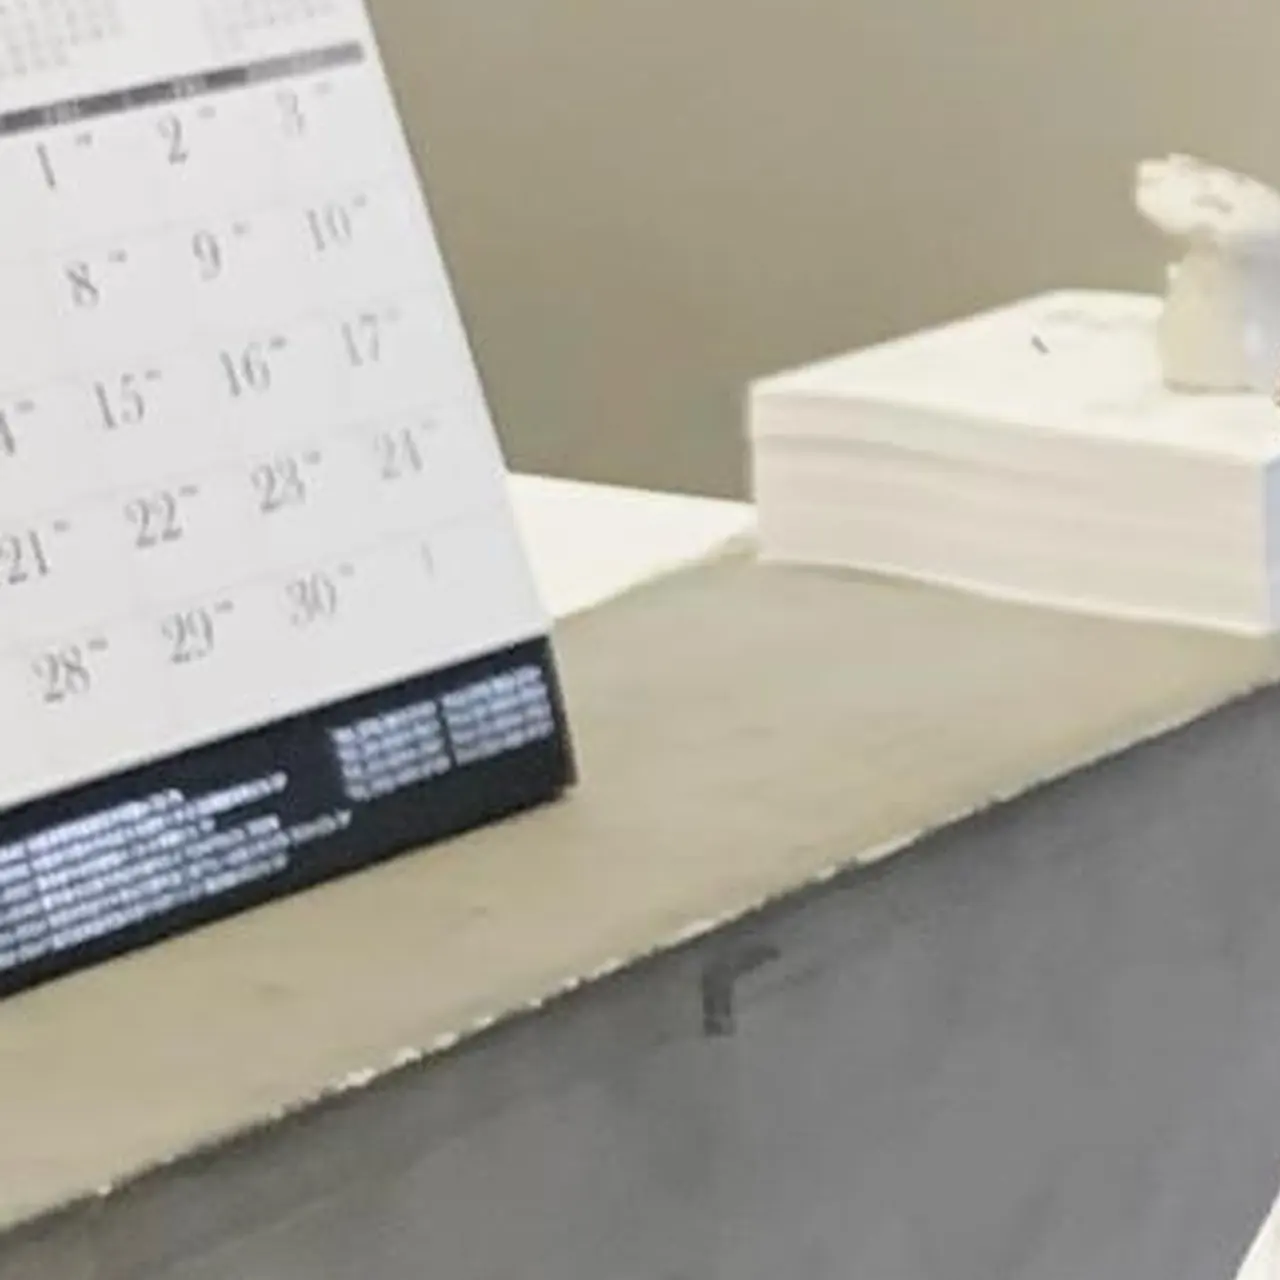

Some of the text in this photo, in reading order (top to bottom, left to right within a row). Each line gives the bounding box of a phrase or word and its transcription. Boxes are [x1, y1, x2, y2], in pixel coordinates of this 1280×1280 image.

[157, 113, 189, 165] 2
[64, 202, 353, 308] 8 9 10
[93, 312, 381, 430] 15 16 17
[0, 529, 49, 585] 21
[125, 489, 184, 550] 22
[251, 455, 307, 513] 23
[31, 645, 91, 704] 28
[162, 606, 216, 665] 29
[285, 571, 338, 628] 30
